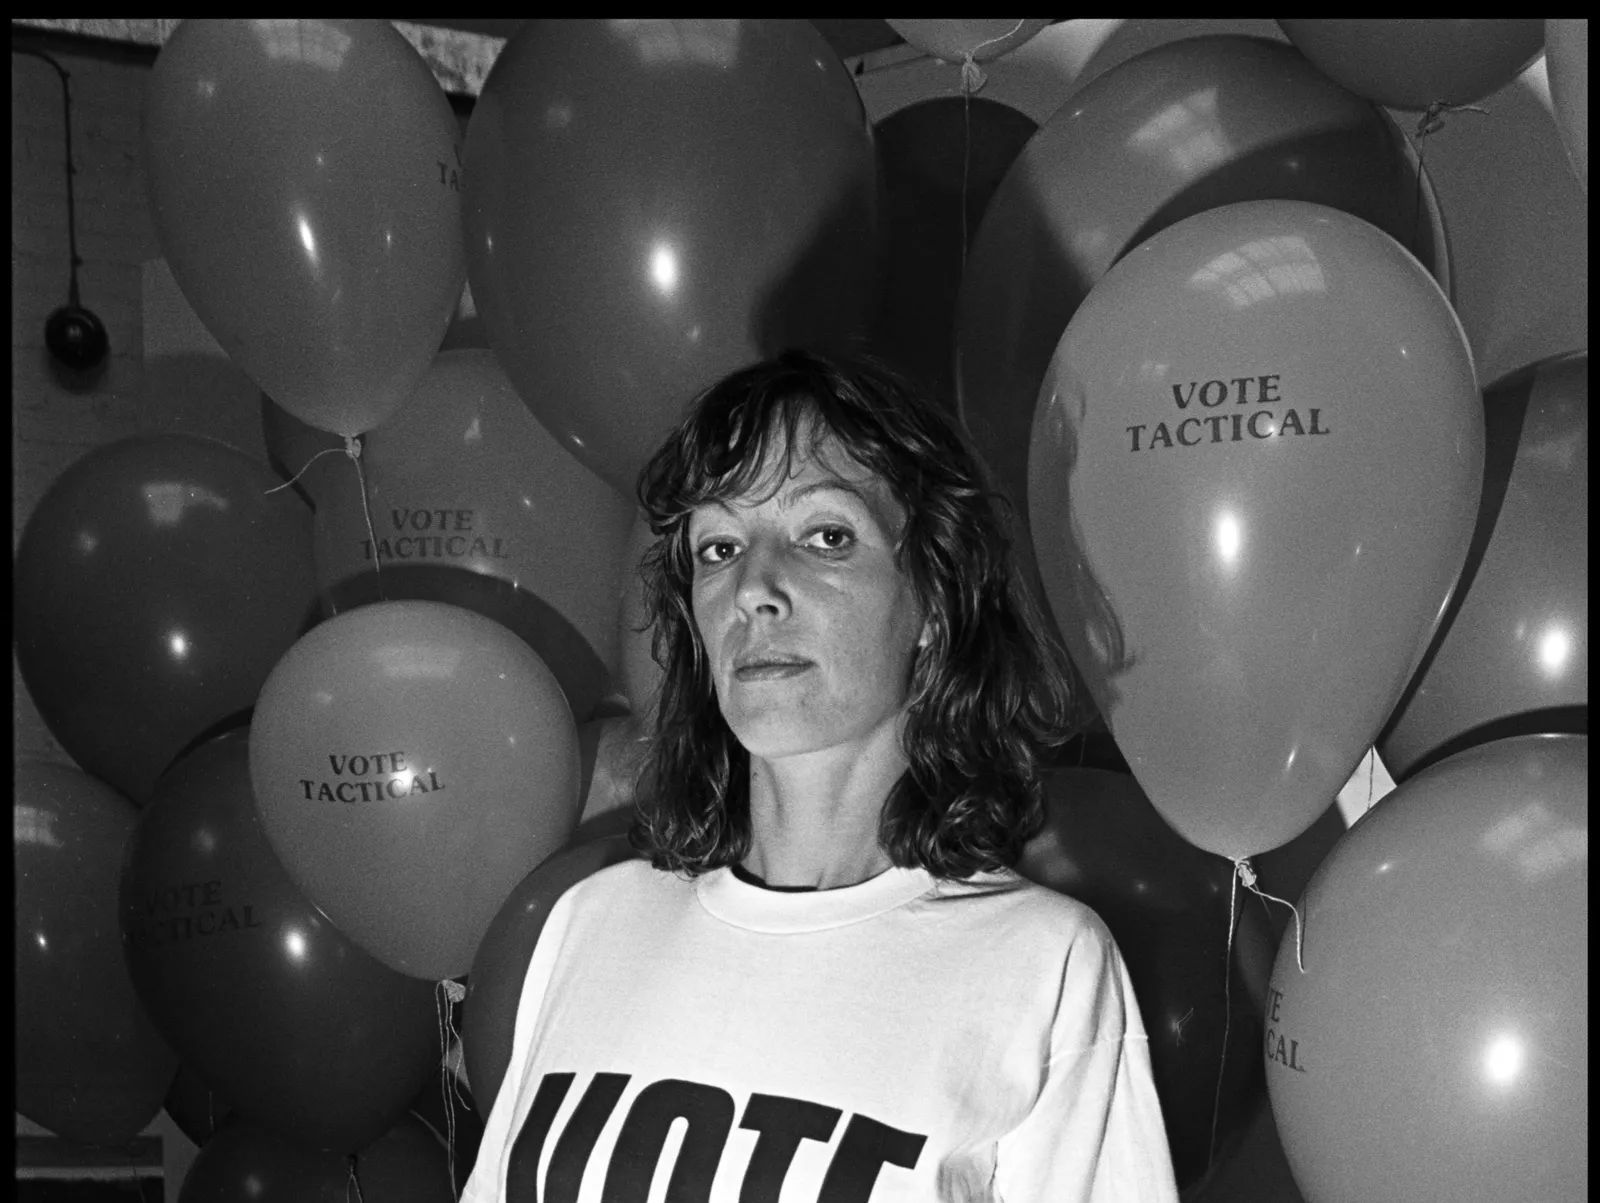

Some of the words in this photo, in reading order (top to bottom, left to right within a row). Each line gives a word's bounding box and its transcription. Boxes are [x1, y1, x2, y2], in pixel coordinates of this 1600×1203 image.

[1172, 374, 1281, 409] VOTE
[1126, 408, 1330, 452] TACTICAL
[392, 509, 473, 531] VOTE
[360, 535, 509, 560] TACTICAL
[329, 751, 407, 776] VOTE
[300, 772, 446, 803] TACTICAL
